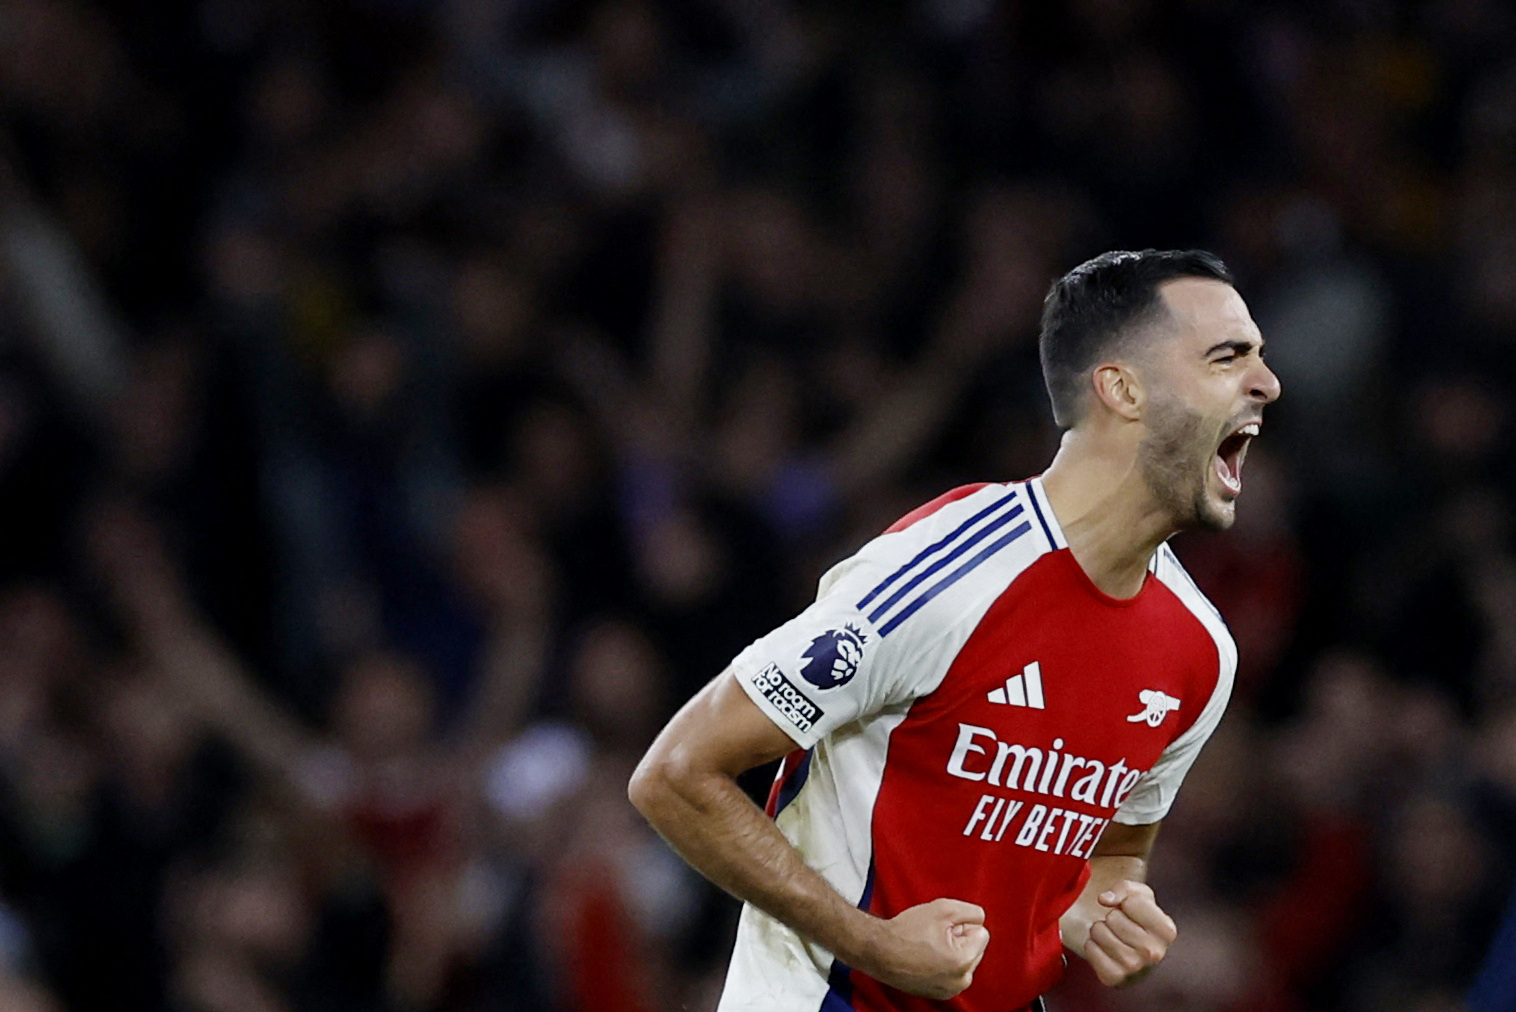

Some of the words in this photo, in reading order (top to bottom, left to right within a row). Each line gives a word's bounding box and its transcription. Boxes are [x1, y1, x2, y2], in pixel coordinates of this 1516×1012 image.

[752, 674, 775, 694] for
[769, 691, 813, 733] racism
[761, 662, 782, 686] No
[779, 683, 816, 719] room
[946, 722, 1147, 809] Emirate
[963, 794, 1024, 842] FLY
[1014, 804, 1110, 860] BETTE
